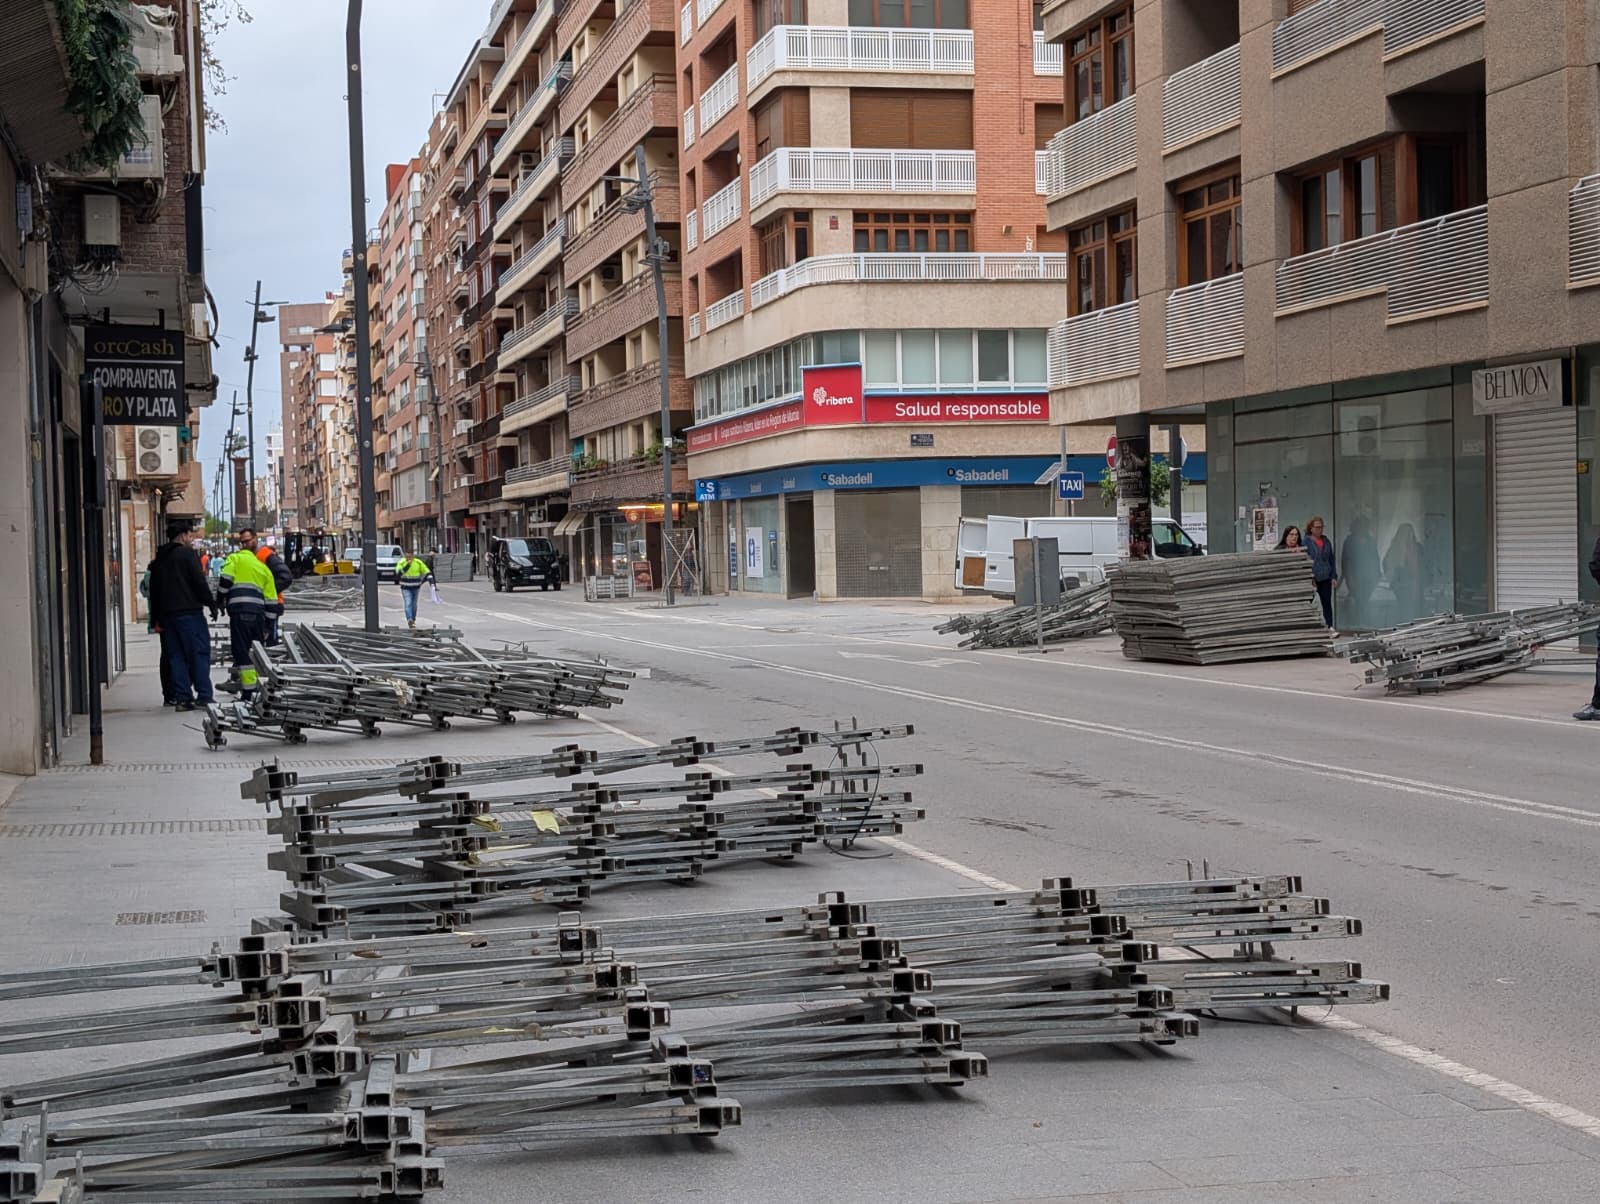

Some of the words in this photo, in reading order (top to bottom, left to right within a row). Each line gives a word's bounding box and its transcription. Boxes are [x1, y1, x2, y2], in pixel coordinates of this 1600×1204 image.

[102, 396, 123, 416] RO
[125, 396, 135, 416] Y
[137, 397, 177, 417] PLATA
[826, 395, 853, 406] ribera
[895, 402, 941, 417] Salud
[945, 400, 1041, 419] responsable
[828, 472, 873, 486] Sabadell
[955, 468, 1009, 481] Sabadell
[1060, 479, 1082, 491] TAXI
[699, 493, 716, 501] ATM
